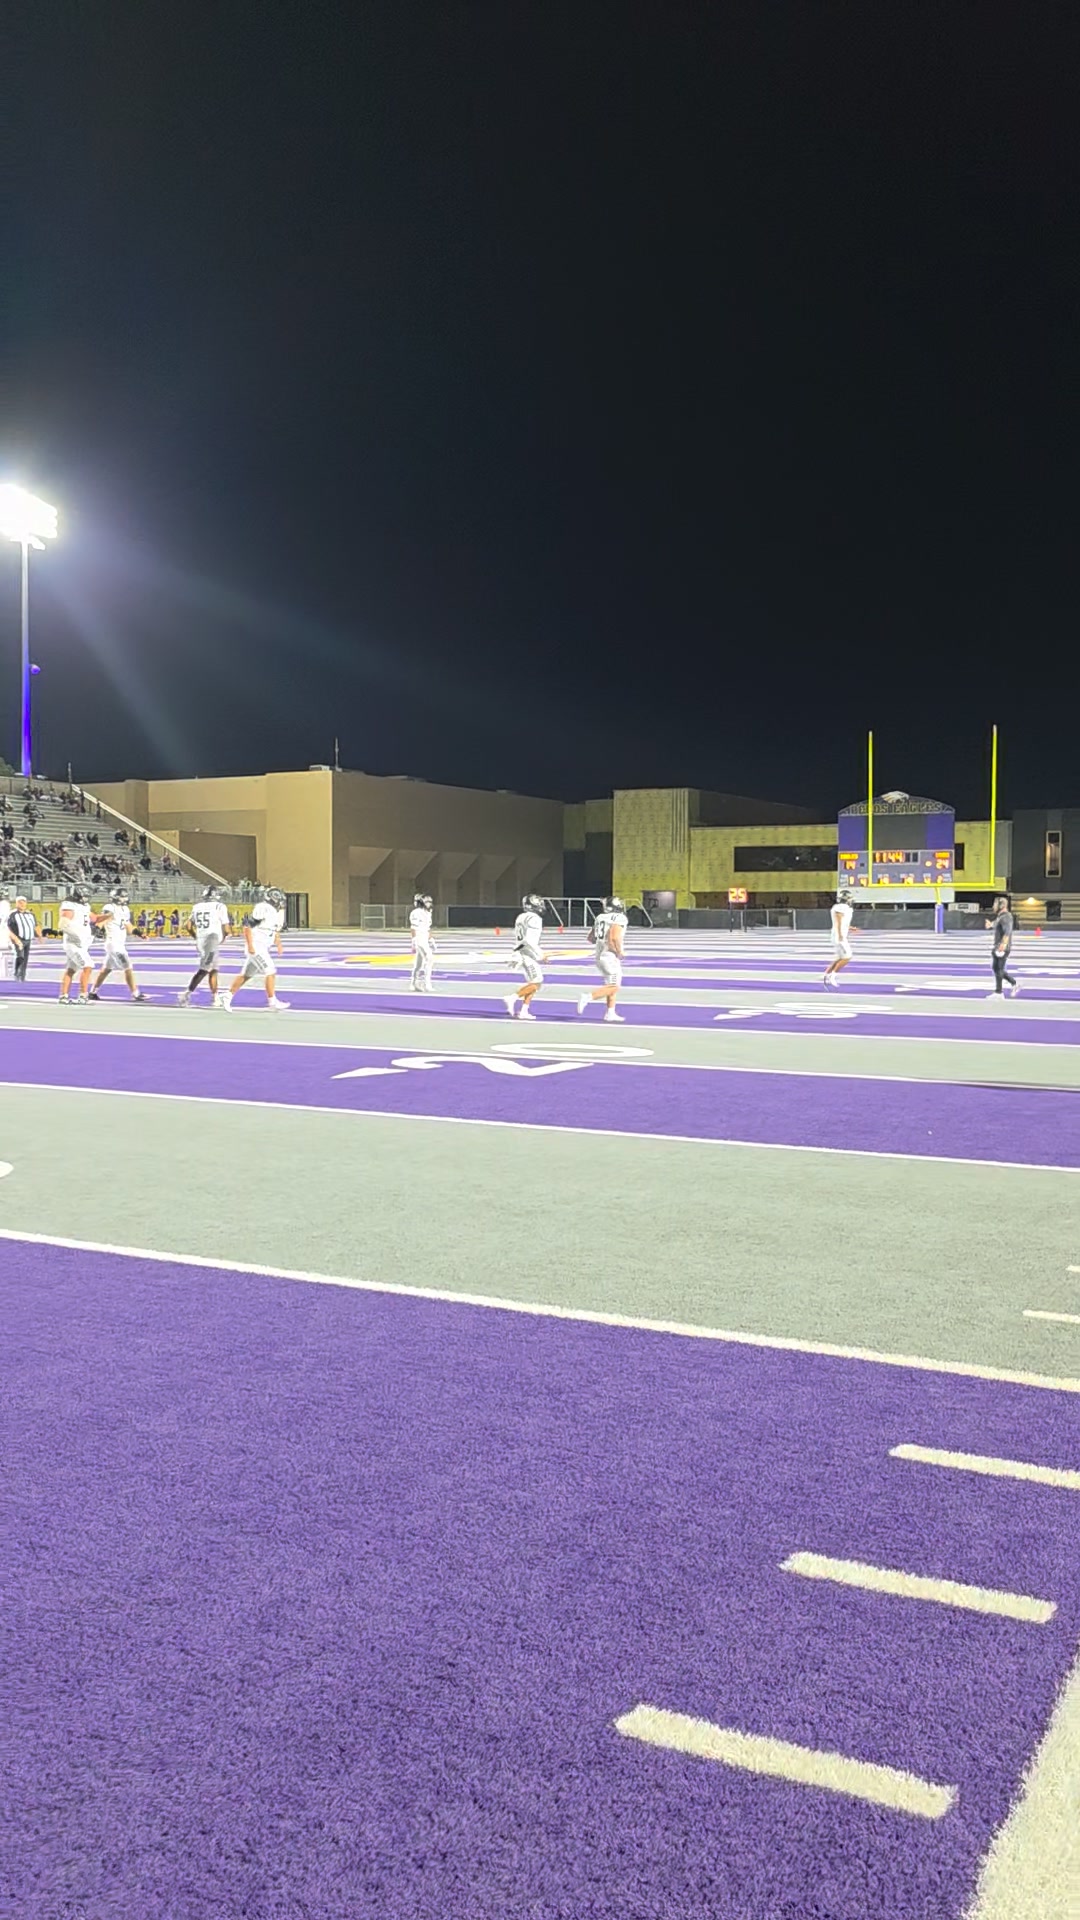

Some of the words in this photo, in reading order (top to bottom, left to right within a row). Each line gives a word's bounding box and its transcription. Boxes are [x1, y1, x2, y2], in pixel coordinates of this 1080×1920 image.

[729, 888, 748, 903] 25
[196, 911, 210, 929] 55
[391, 1042, 655, 1077] 20
